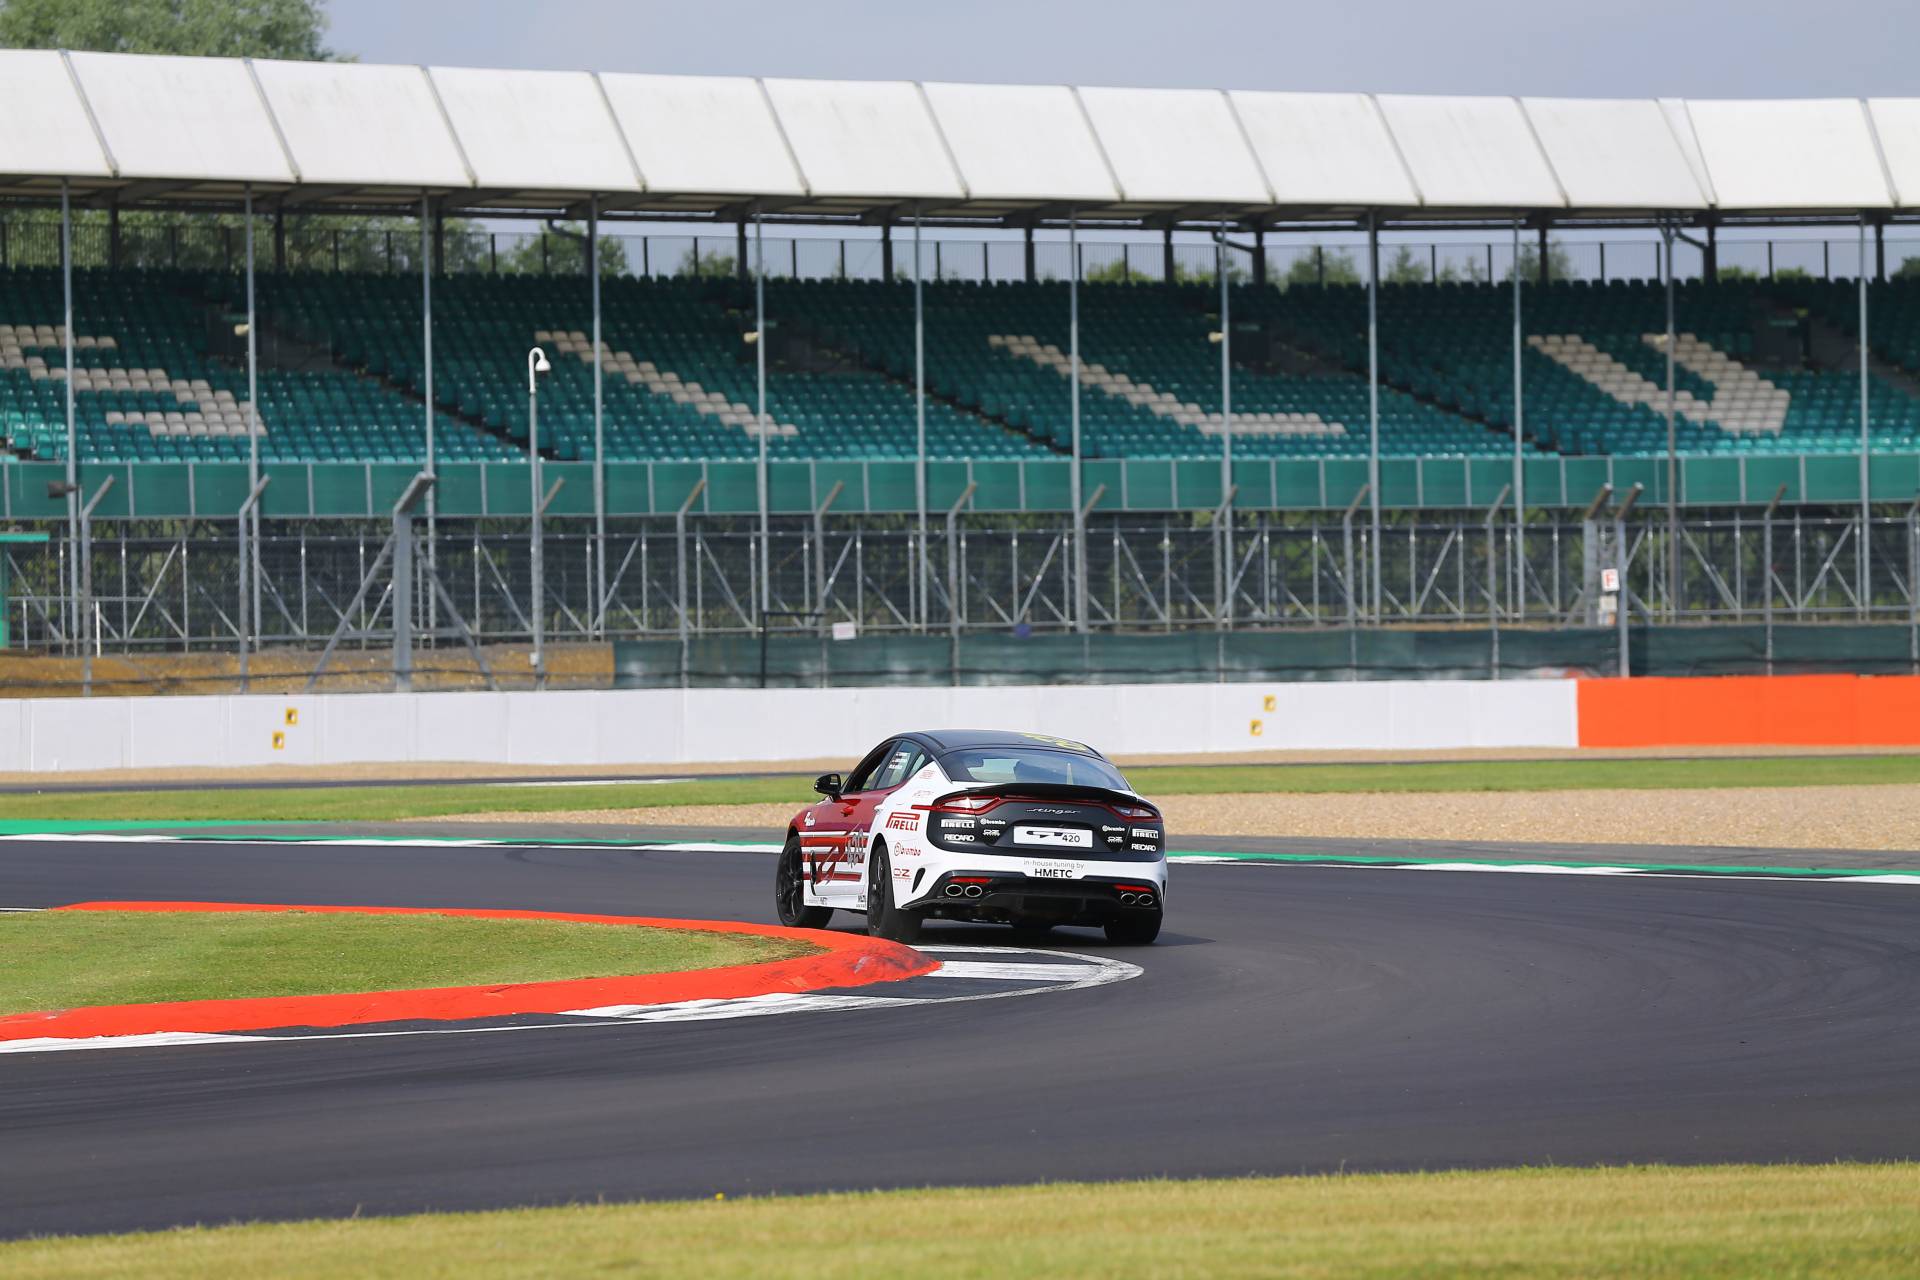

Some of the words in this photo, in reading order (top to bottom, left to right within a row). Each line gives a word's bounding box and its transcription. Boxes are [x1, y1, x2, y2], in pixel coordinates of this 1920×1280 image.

[886, 812, 920, 831] PIRELLI
[941, 819, 975, 828] PIRELLI
[944, 833, 975, 842] RECARO
[1132, 828, 1158, 839] PIRELLI
[1062, 834, 1081, 843] 420
[1131, 843, 1157, 852] RECARO
[1053, 861, 1075, 869] tuning
[1034, 868, 1073, 878] HMETC
